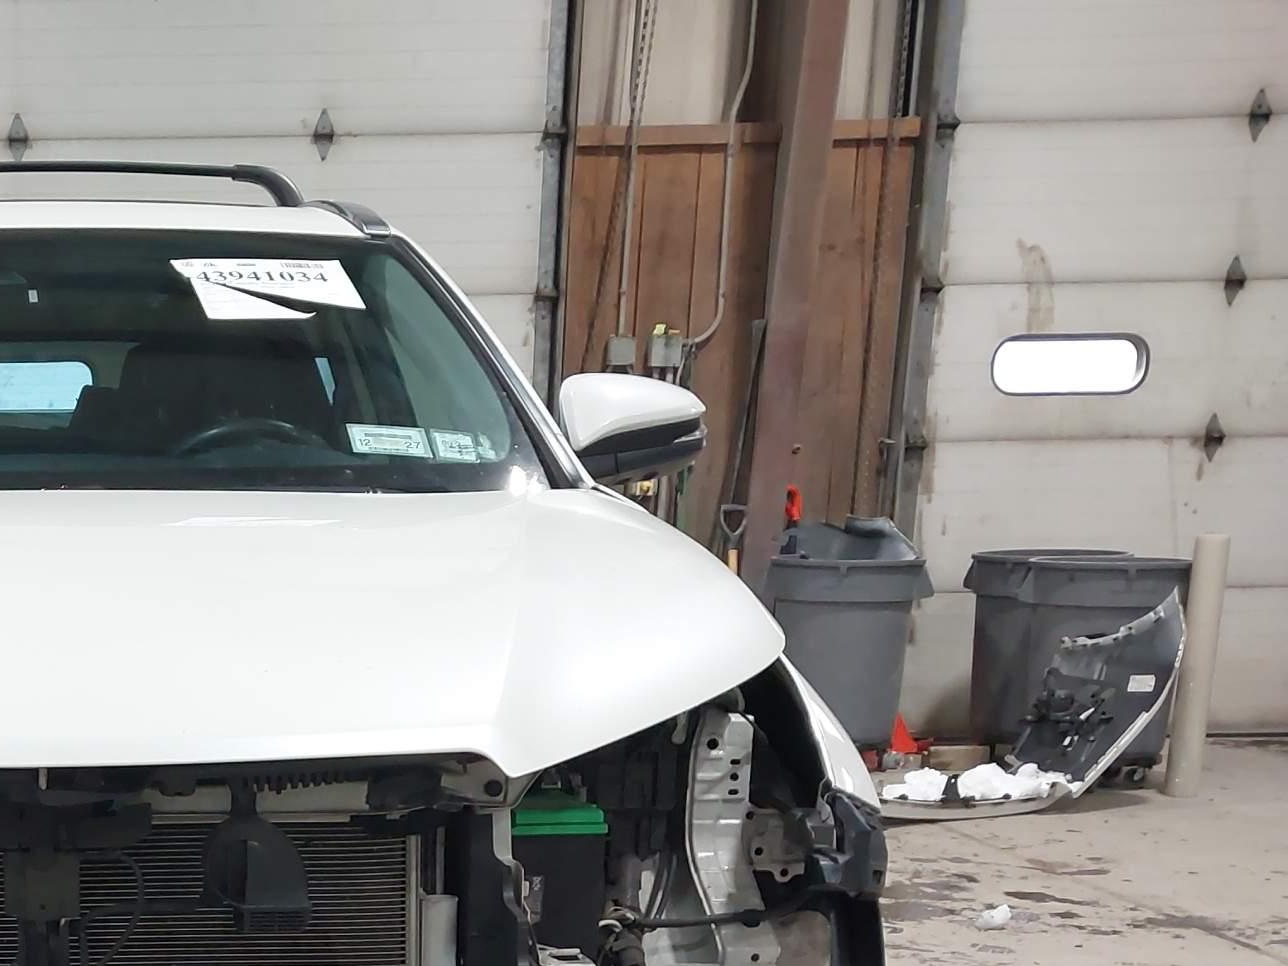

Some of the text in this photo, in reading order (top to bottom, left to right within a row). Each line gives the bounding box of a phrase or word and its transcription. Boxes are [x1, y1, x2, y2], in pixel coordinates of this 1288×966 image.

[196, 270, 329, 283] 43941034
[358, 438, 421, 449] 12 27
